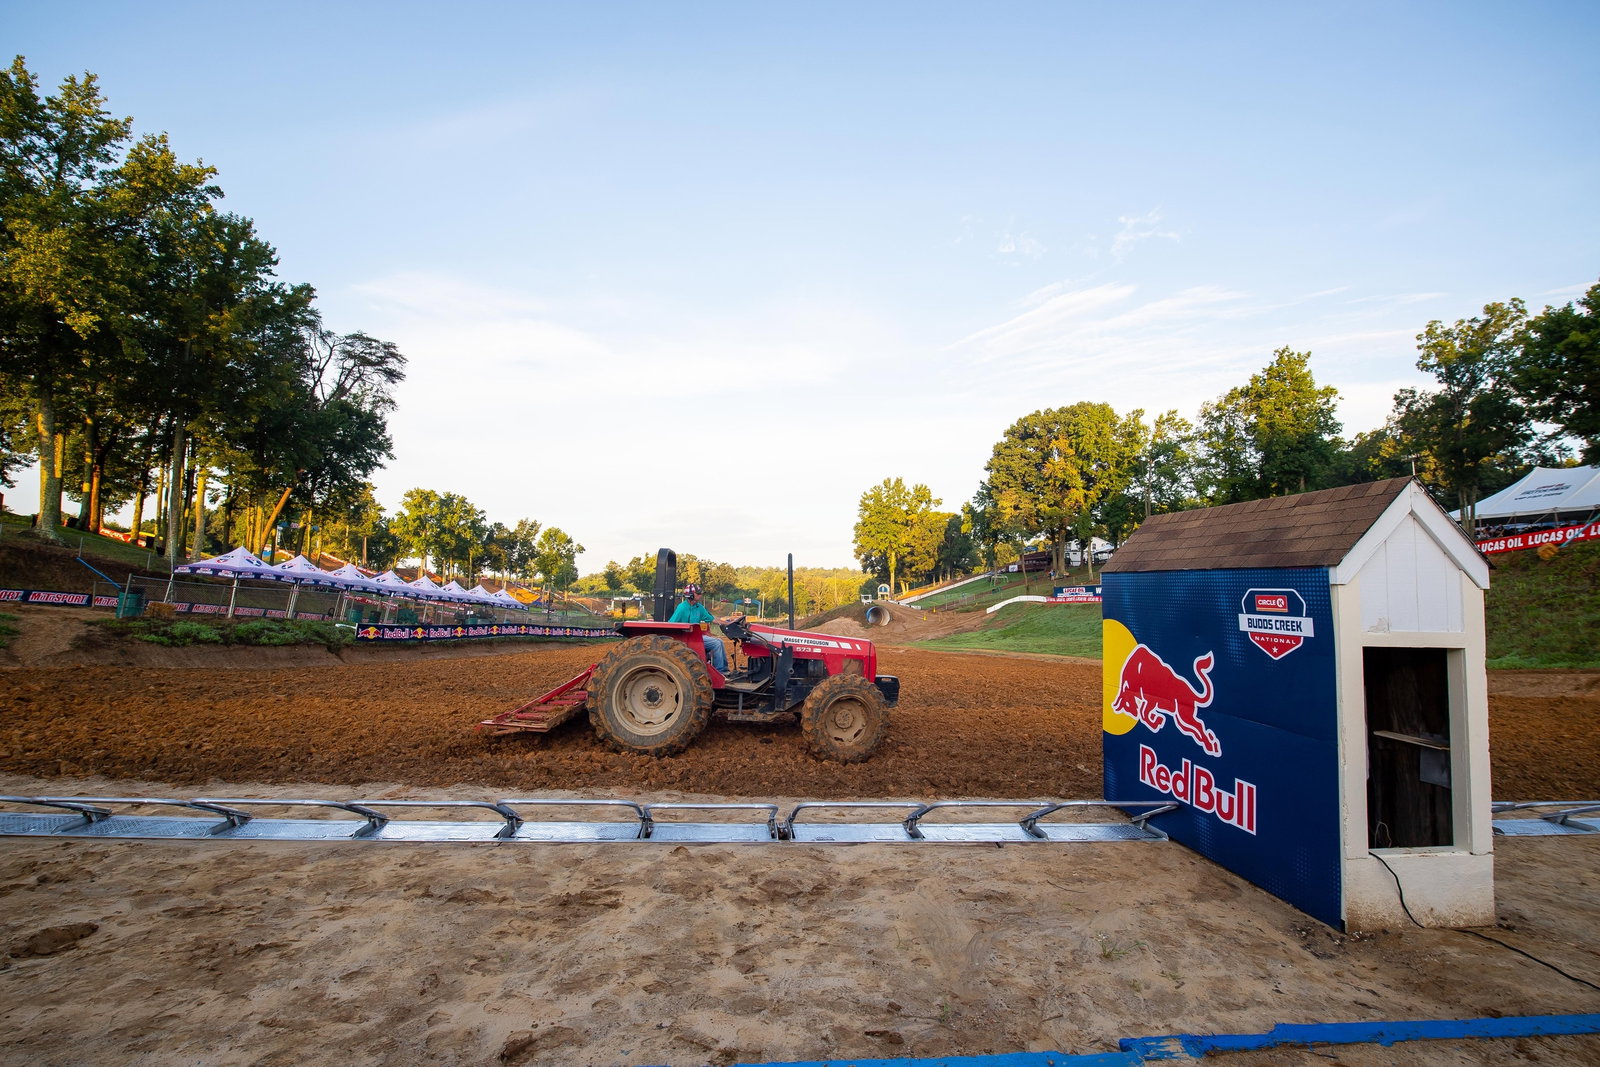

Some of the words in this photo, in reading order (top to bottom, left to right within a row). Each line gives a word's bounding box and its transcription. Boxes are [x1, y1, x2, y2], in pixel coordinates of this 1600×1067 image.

[1507, 537, 1523, 549] OIL
[1528, 530, 1564, 546] LUCAS
[1277, 598, 1285, 608] K
[1247, 617, 1273, 630] BUDDS
[1274, 619, 1303, 633] CREEK
[803, 638, 829, 646] FERGUSON
[1254, 636, 1296, 645] NATIONAL
